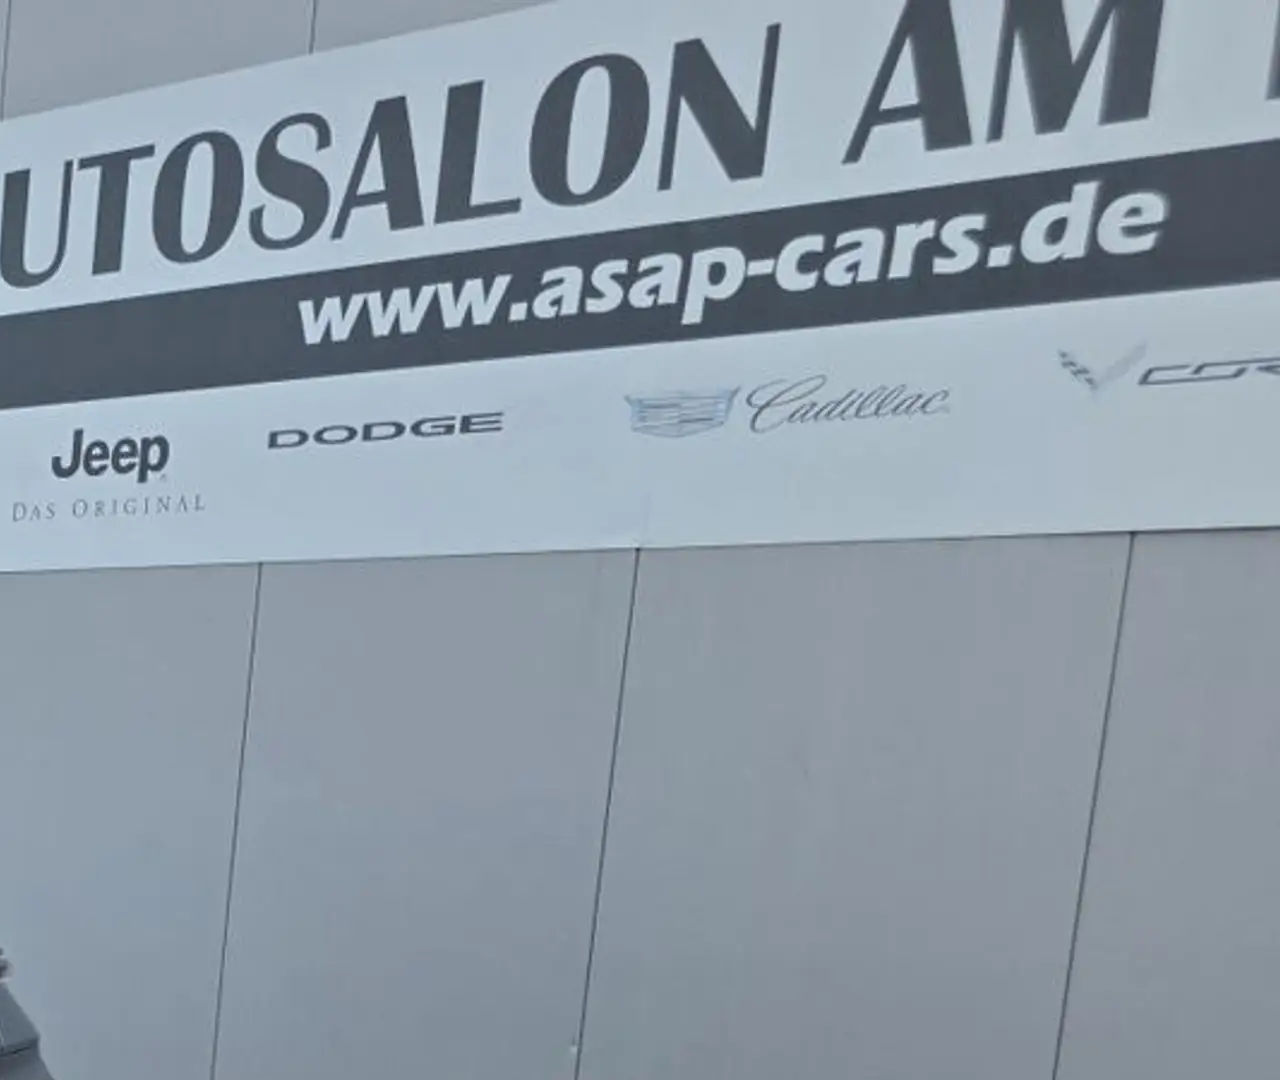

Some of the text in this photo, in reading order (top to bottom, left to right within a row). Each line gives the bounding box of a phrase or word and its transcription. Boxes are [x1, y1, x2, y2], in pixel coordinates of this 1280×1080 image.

[842, 0, 1165, 164] AM
[297, 180, 1170, 346] www.asap-cars.de
[267, 412, 504, 450] DODGE
[745, 374, 952, 434] Cadillac
[51, 428, 170, 483] Jeep
[12, 494, 206, 522] DAS ORIGINAL
